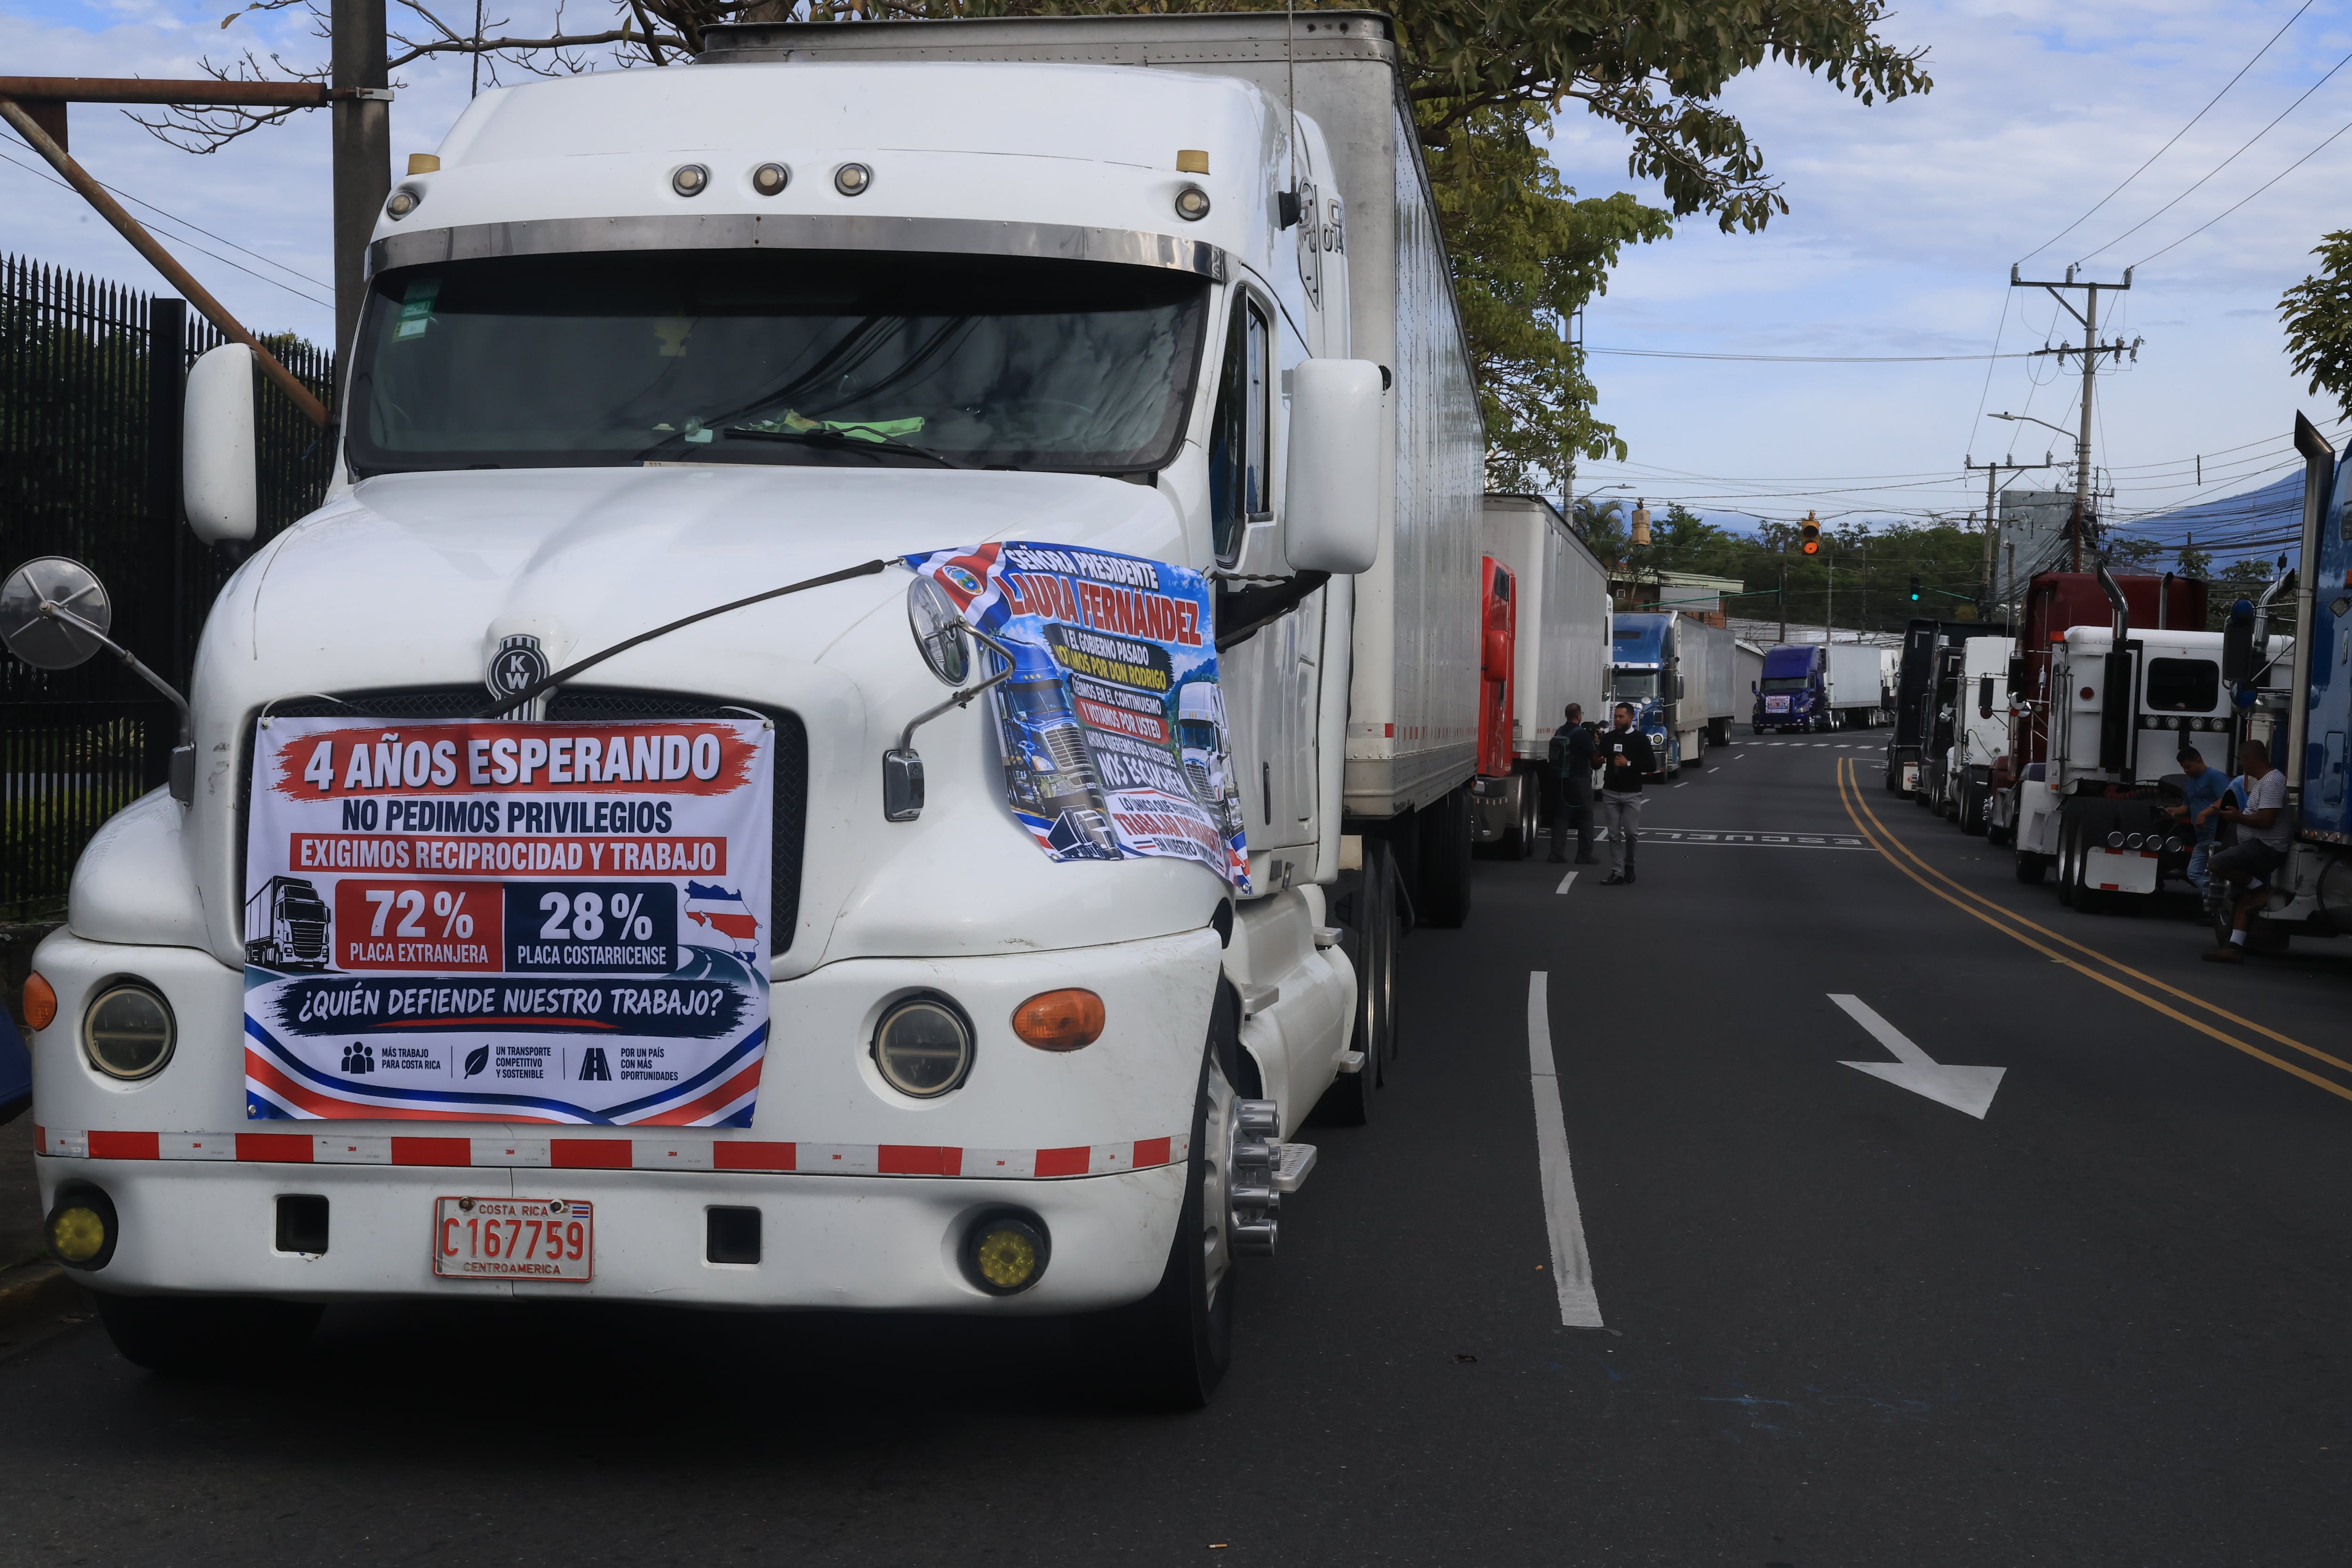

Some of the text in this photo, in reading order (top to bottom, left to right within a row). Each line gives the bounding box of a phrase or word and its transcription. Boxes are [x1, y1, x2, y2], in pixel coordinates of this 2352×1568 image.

[1005, 544, 1159, 589] SEÑORA PRESIDENTE
[992, 573, 1202, 646] LAURA FERNÁNDEZ
[1068, 630, 1080, 650] EL
[1079, 632, 1116, 659] GOBIERNO
[1116, 641, 1149, 666] PASADO
[1090, 656, 1109, 678] POR
[1109, 661, 1128, 682] DON
[1128, 665, 1167, 690] RODRIGO
[1095, 686, 1106, 702] EN
[1105, 688, 1115, 705] EL
[1114, 691, 1161, 715] CONTINUISMO
[1081, 701, 1161, 739] Y VOTAMOS POR USTED
[1086, 730, 1176, 768] AHORA QUEREMOS QUE USTEDES
[304, 733, 720, 790] 4 AÑOS ESPERANDO
[1097, 752, 1128, 787] NOS
[1118, 797, 1134, 811] LO
[1128, 795, 1158, 812] ÚNICO
[1153, 800, 1175, 813] QUE
[343, 800, 672, 834] NO PEDIMOS PRIVILEGIOS
[1112, 813, 1184, 837] TRABAJAR
[300, 840, 716, 871] EXIGIMOS RECIPROCIDAD Y TRABAJO
[1152, 837, 1169, 852] EN
[1163, 838, 1198, 856] NUESTRO
[350, 945, 488, 963] PLACA EXTRANJERA
[518, 946, 666, 966] PLACA COSTARRICENSE
[299, 983, 723, 1022] ¿QUIÉN DEFIENDE NUESTRO TRABAJO?
[382, 1047, 429, 1058] MÁS TRABAJO
[496, 1047, 551, 1057] UN TRANSPORTE
[496, 1058, 542, 1067] COMPETITIVO
[621, 1047, 664, 1058] POR UN PAÍS
[382, 1060, 441, 1069] PARA COSTA RICA
[496, 1069, 544, 1079] Y SOSTENIBLE
[621, 1059, 653, 1069] CON MÁS
[621, 1071, 678, 1081] OPORTUNIDADES
[479, 1204, 549, 1216] COSTA RICA
[443, 1218, 584, 1260] C167759
[463, 1262, 561, 1274] CENTROAMERICA
